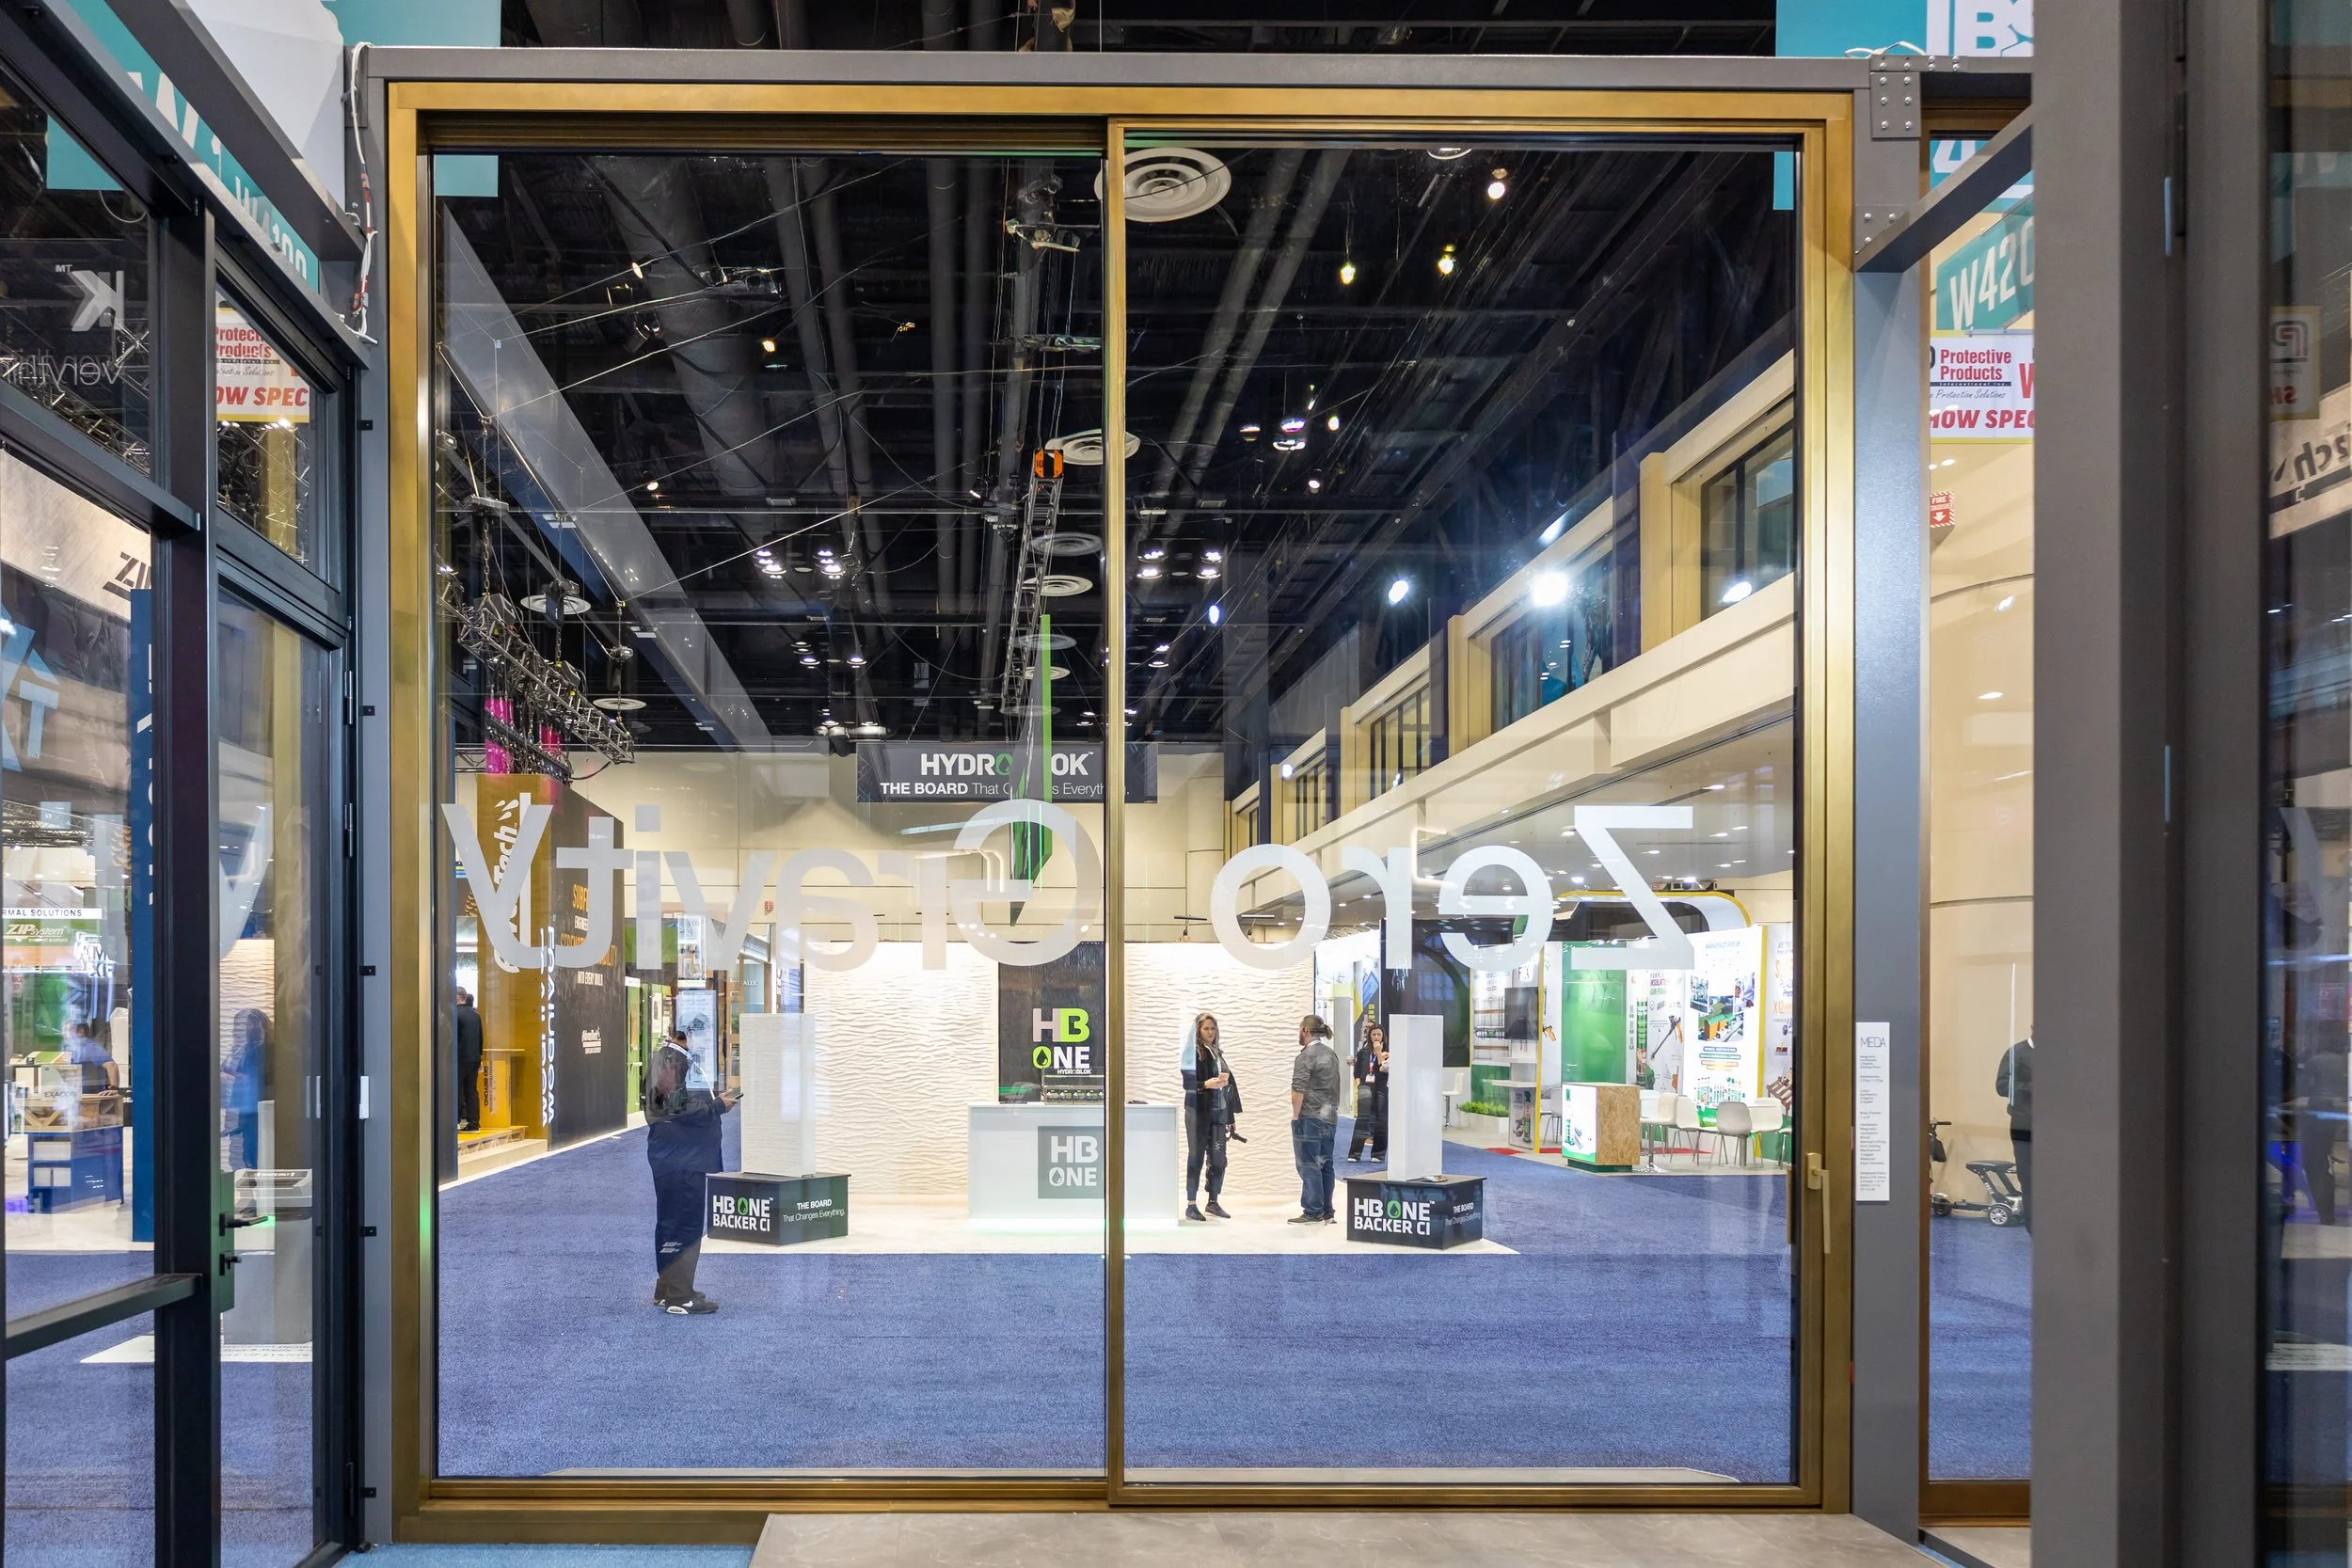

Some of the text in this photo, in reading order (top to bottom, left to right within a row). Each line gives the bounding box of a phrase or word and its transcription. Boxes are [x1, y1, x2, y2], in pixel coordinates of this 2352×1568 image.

[1941, 349, 2011, 364] Protective
[1941, 366, 2002, 380] Products
[1975, 388, 2006, 399] Solutions
[920, 752, 1089, 776] HYDROOK
[881, 782, 910, 795] THE
[914, 783, 968, 795] BOARD
[972, 783, 1002, 795] That
[1032, 1007, 1090, 1043] HB
[1860, 1037, 1886, 1047] MEDA
[1032, 1046, 1090, 1069] ONE
[1051, 1135, 1099, 1163] HB
[1049, 1167, 1097, 1186] ONE
[712, 1196, 770, 1218] HB ONE
[797, 1198, 832, 1210] THE BOARD
[1354, 1197, 1430, 1221] HB ONE
[713, 1213, 770, 1231] BACKER CI
[783, 1213, 795, 1222] That
[795, 1211, 818, 1221] Changes
[1355, 1217, 1430, 1235] BACKER CI
